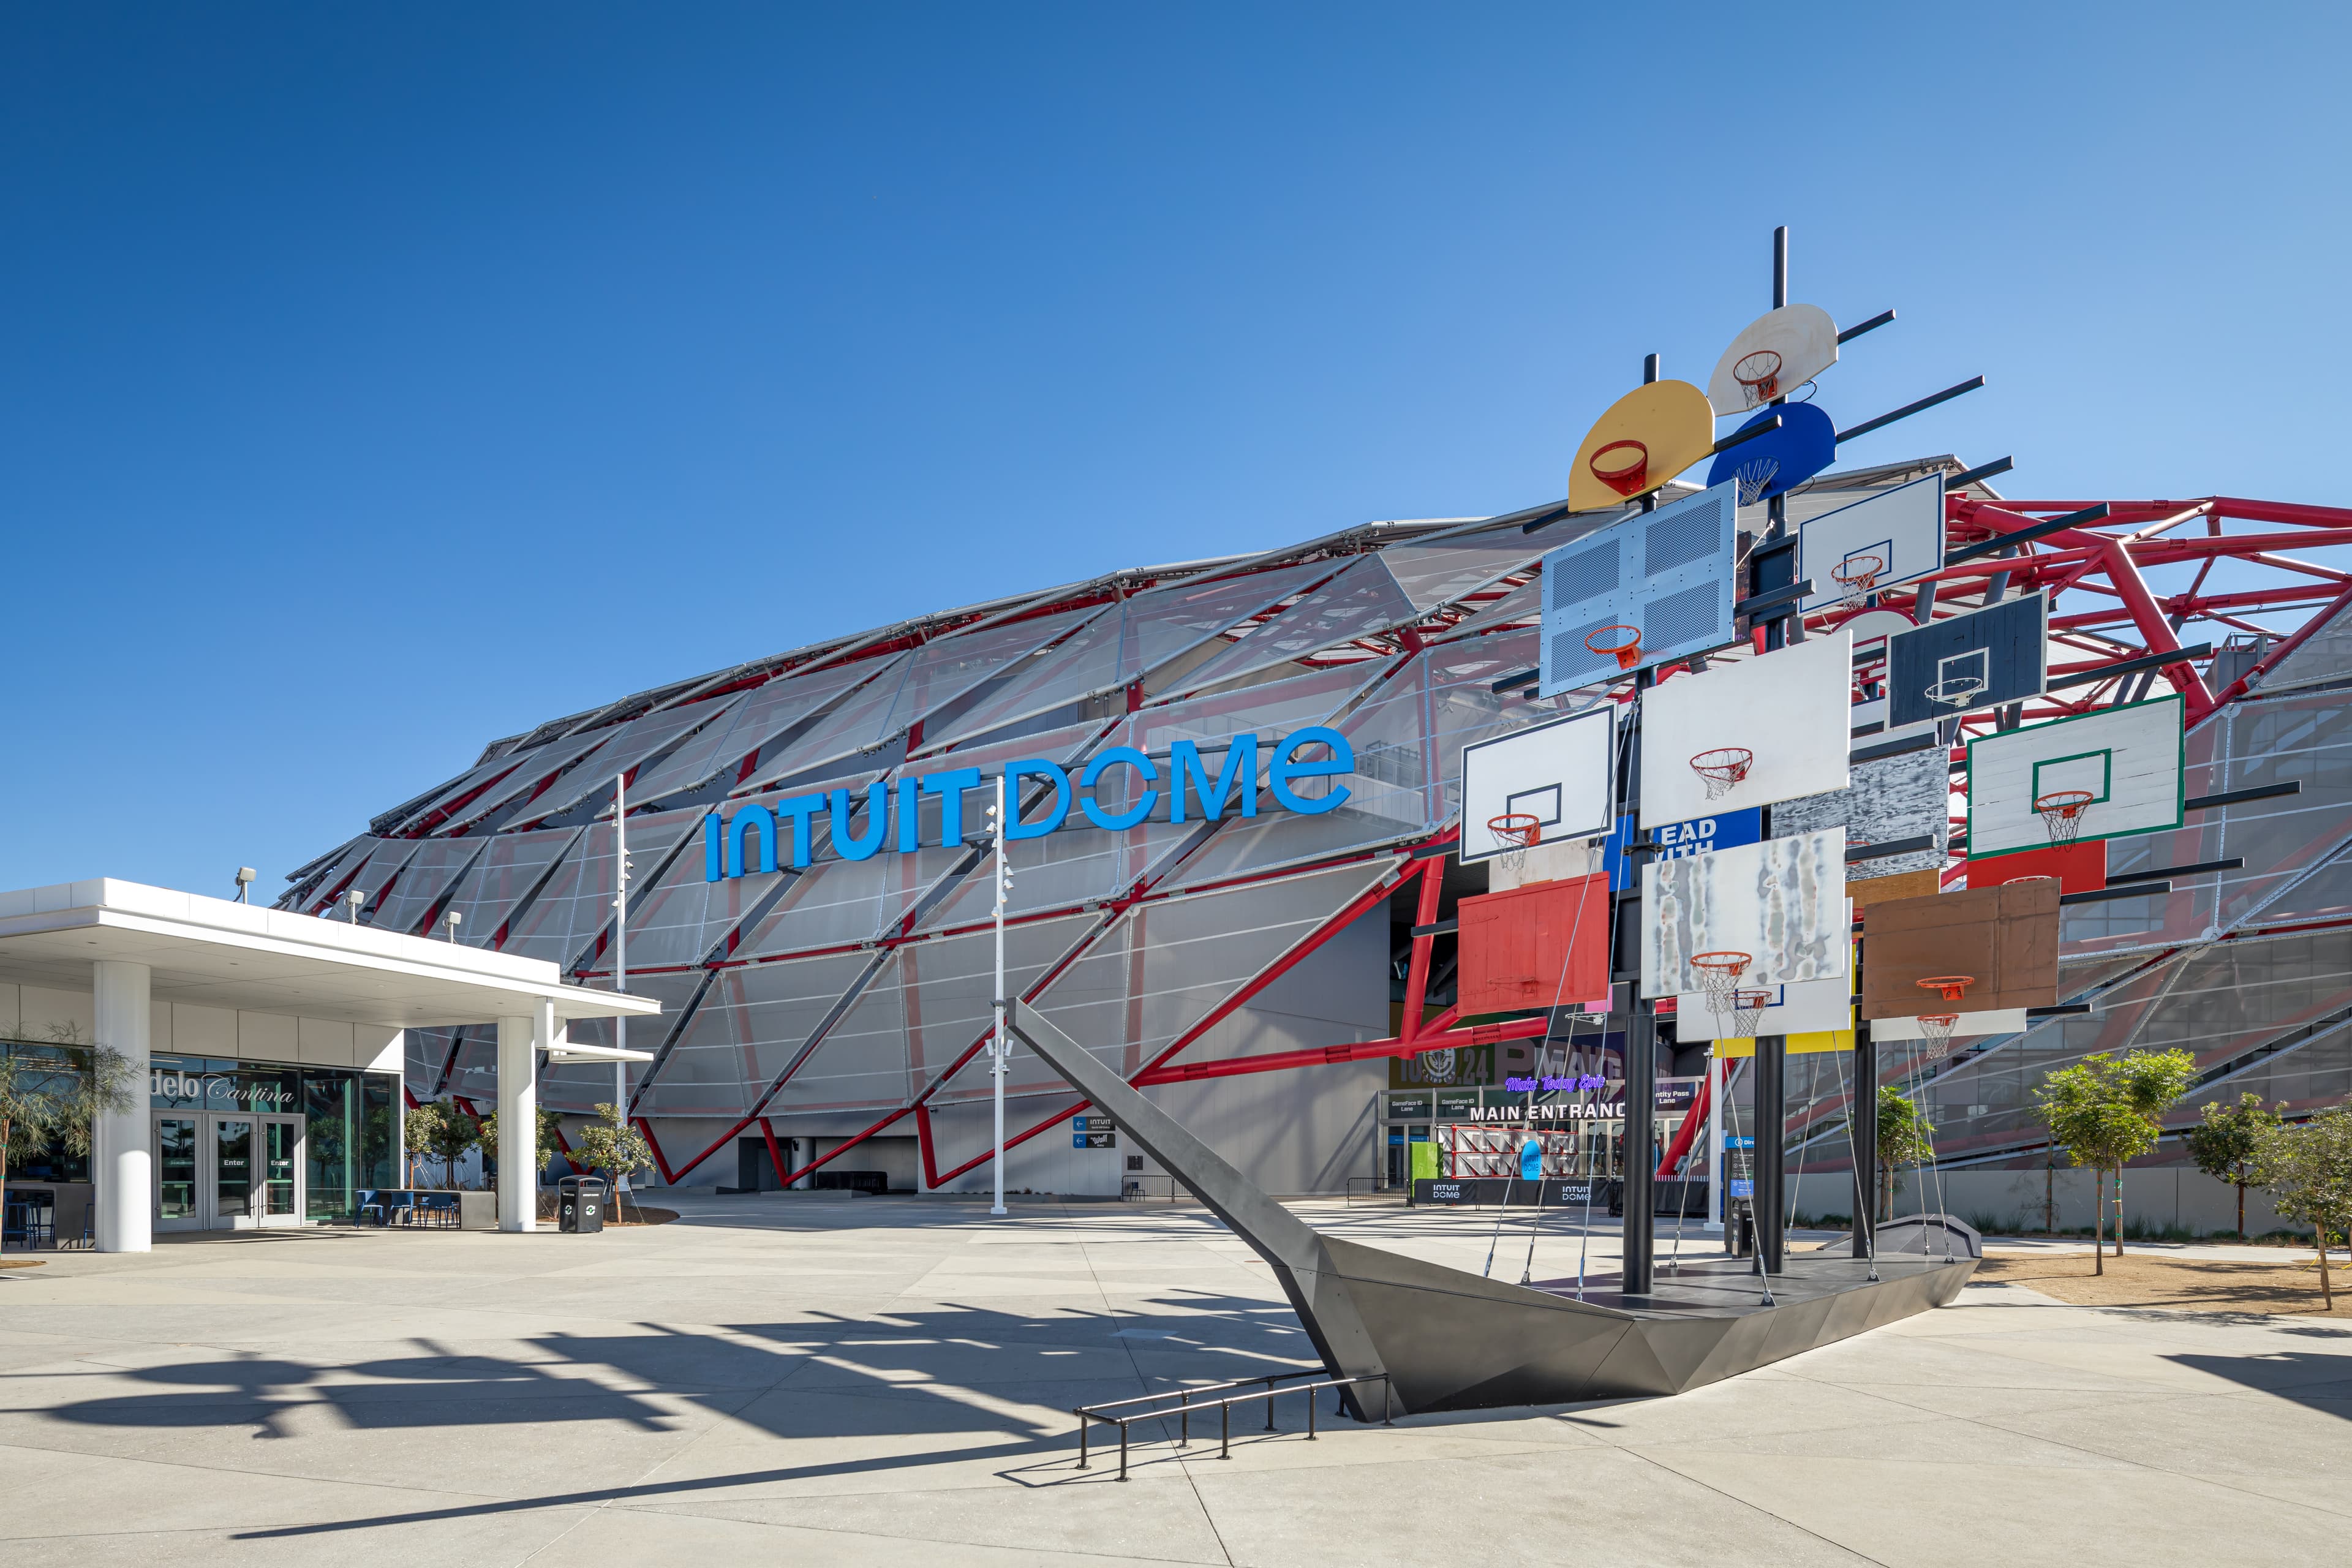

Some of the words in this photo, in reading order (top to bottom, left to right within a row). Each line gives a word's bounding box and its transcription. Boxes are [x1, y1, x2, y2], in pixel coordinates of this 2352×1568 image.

[1661, 818, 1717, 846] EAD
[150, 1069, 200, 1098] delo
[201, 1073, 295, 1103] Cantina
[1422, 1069, 1456, 1084] CLIPPERS
[1505, 1076, 1538, 1092] Make
[1541, 1074, 1577, 1093] Today
[1578, 1073, 1605, 1092] Epic
[1470, 1106, 1520, 1121] MAIN
[1528, 1102, 1626, 1120] ENTRANC
